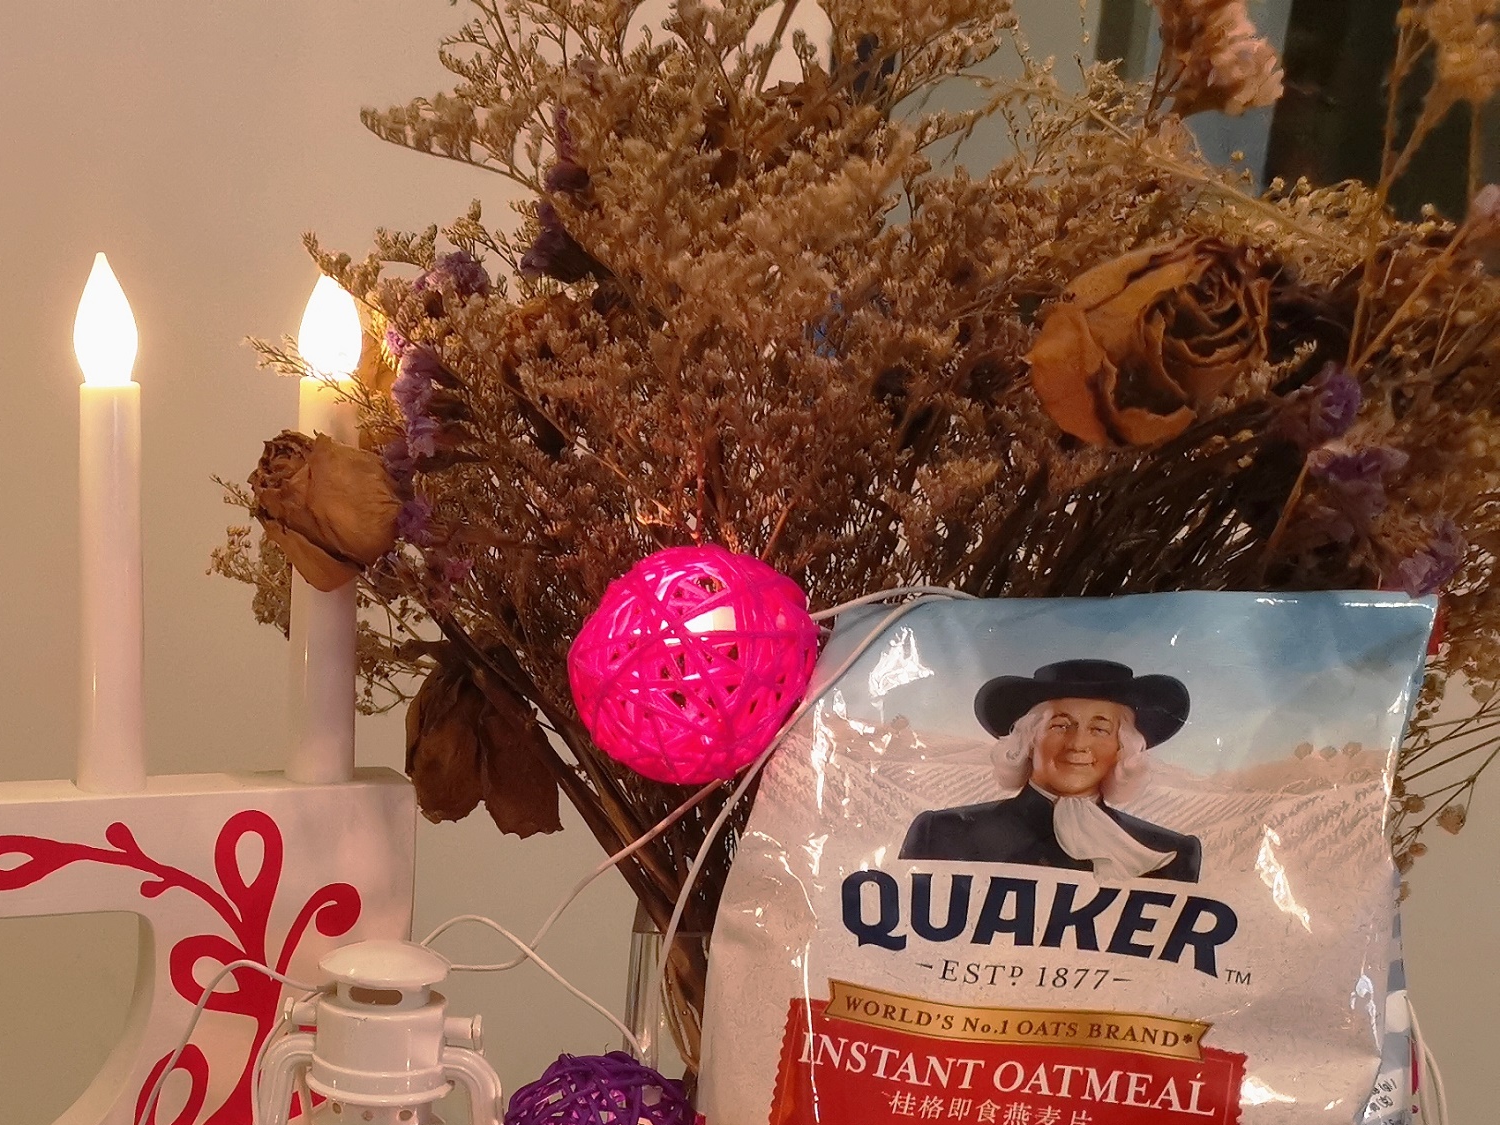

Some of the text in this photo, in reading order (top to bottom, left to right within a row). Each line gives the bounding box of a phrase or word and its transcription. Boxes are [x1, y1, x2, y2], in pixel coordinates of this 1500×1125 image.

[840, 869, 1238, 977] QUAKER
[845, 996, 954, 1031] WORLD'S
[962, 1017, 1008, 1035] No.1
[1016, 1018, 1079, 1038] OATS
[798, 1031, 1217, 1117] INSTANT OATMEAL
